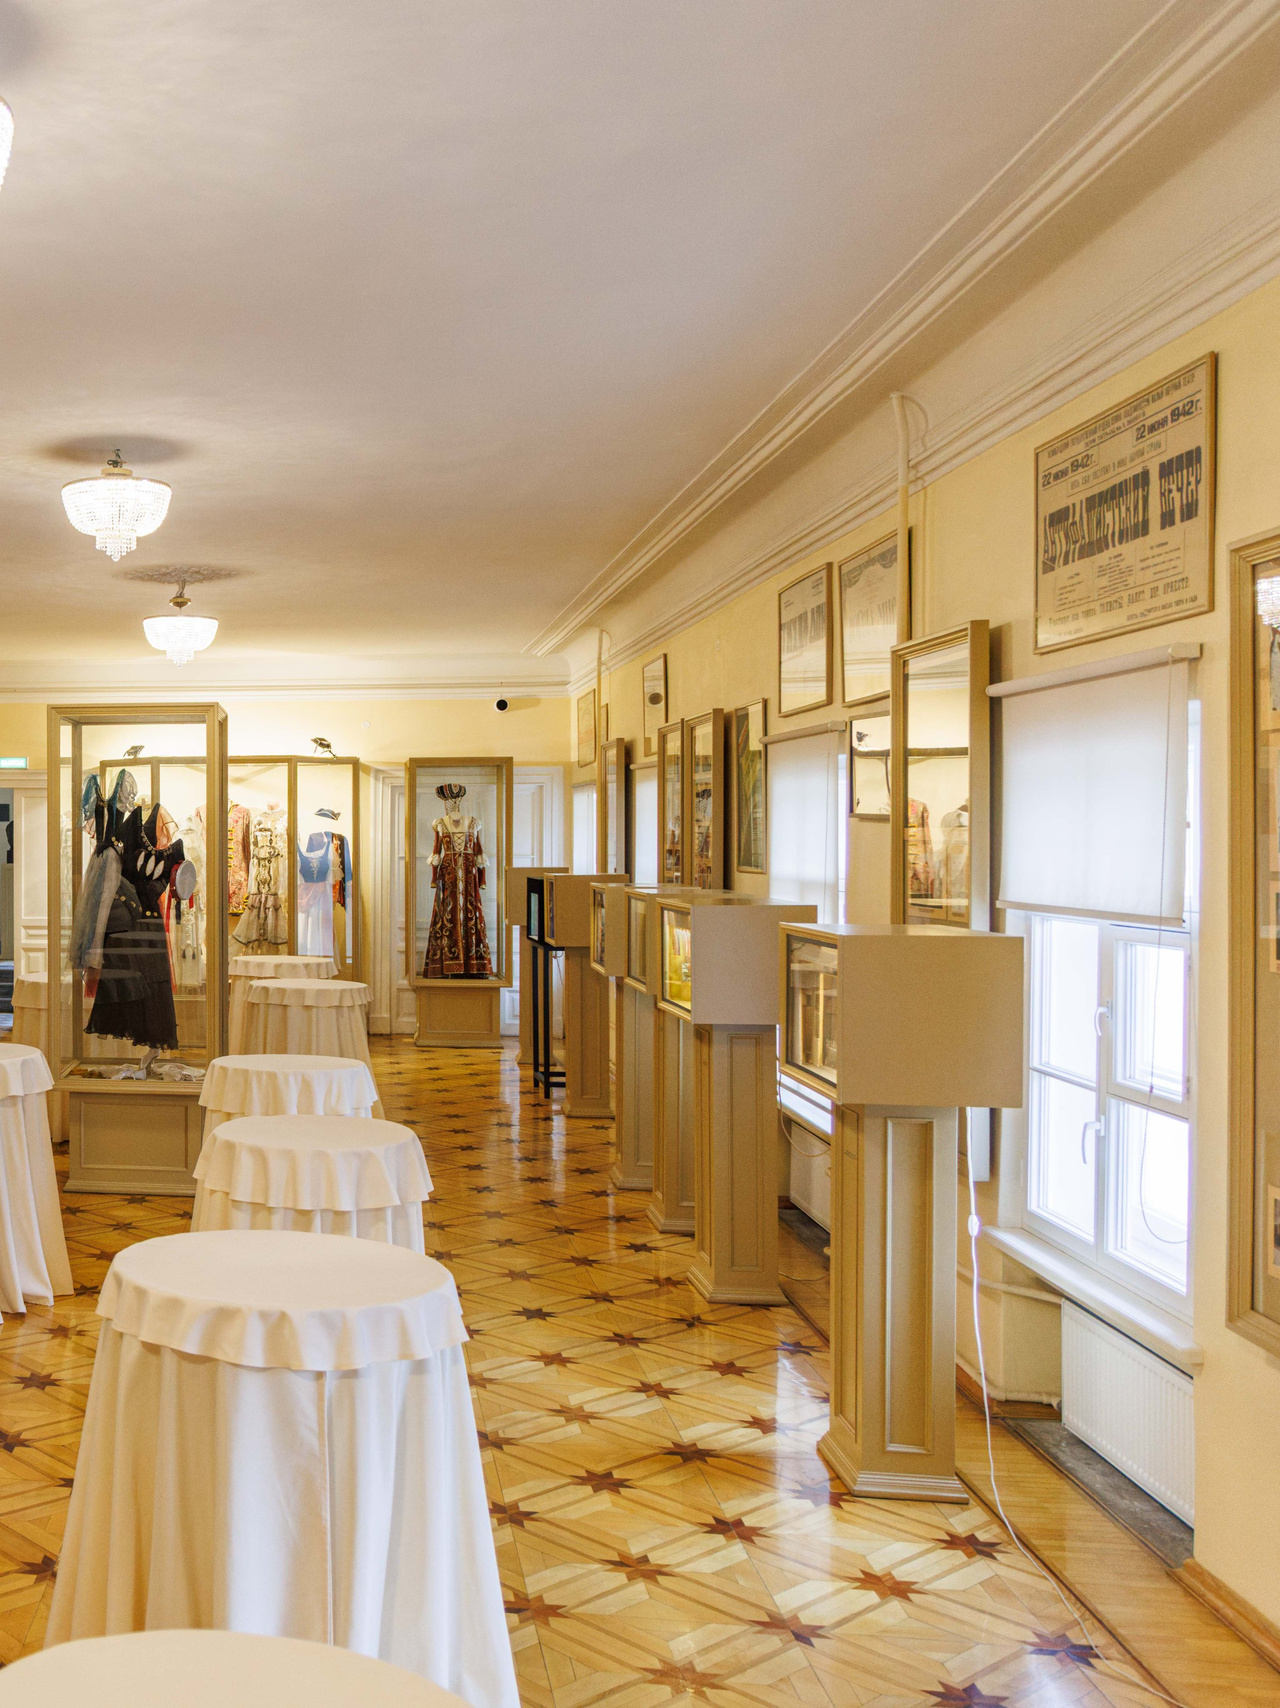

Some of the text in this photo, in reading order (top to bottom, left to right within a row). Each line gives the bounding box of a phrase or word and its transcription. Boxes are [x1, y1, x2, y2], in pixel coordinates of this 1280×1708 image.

[1135, 423, 1145, 441] 22
[1042, 471, 1051, 487] 22
[1042, 469, 1149, 574] АНТИФАШИСТСКИЙ
[1159, 445, 1201, 530] ВЕЧЕР
